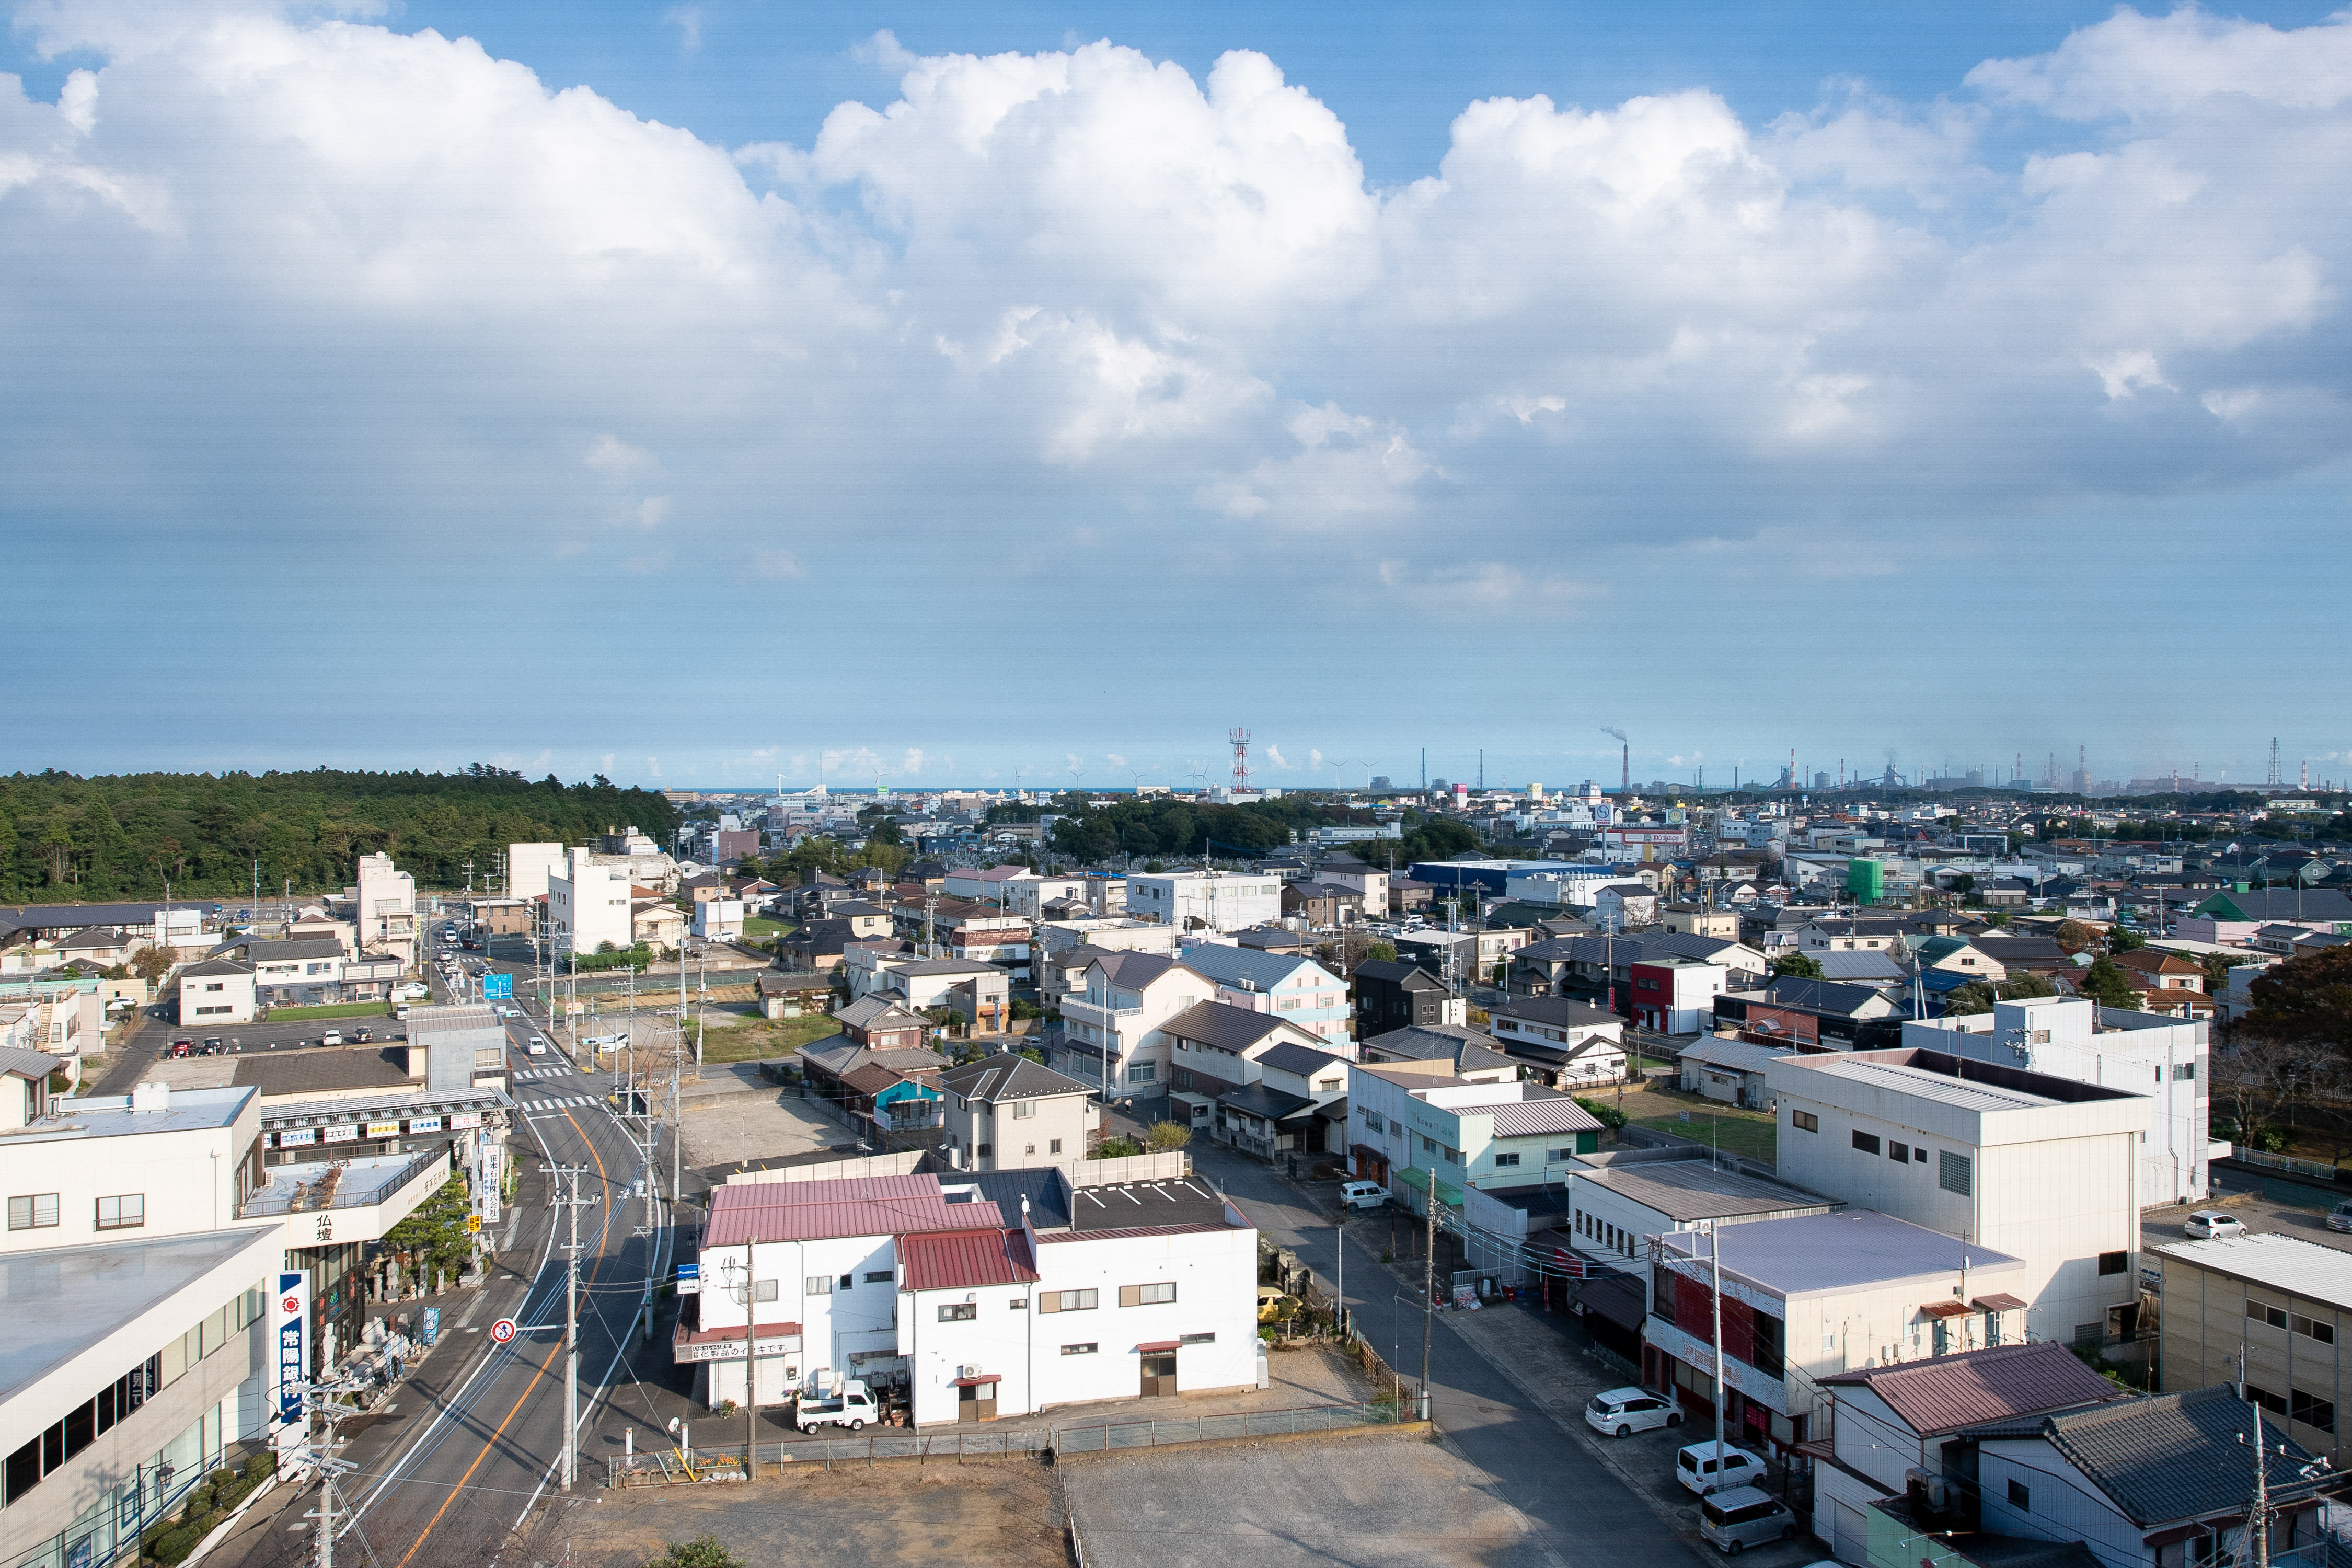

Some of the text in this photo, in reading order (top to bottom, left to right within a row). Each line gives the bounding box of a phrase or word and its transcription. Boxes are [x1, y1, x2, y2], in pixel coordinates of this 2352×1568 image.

[489, 1154, 498, 1217] 笹本石材株式会社
[317, 1214, 333, 1241] 仏壇
[282, 1330, 300, 1399] 常陽銀行
